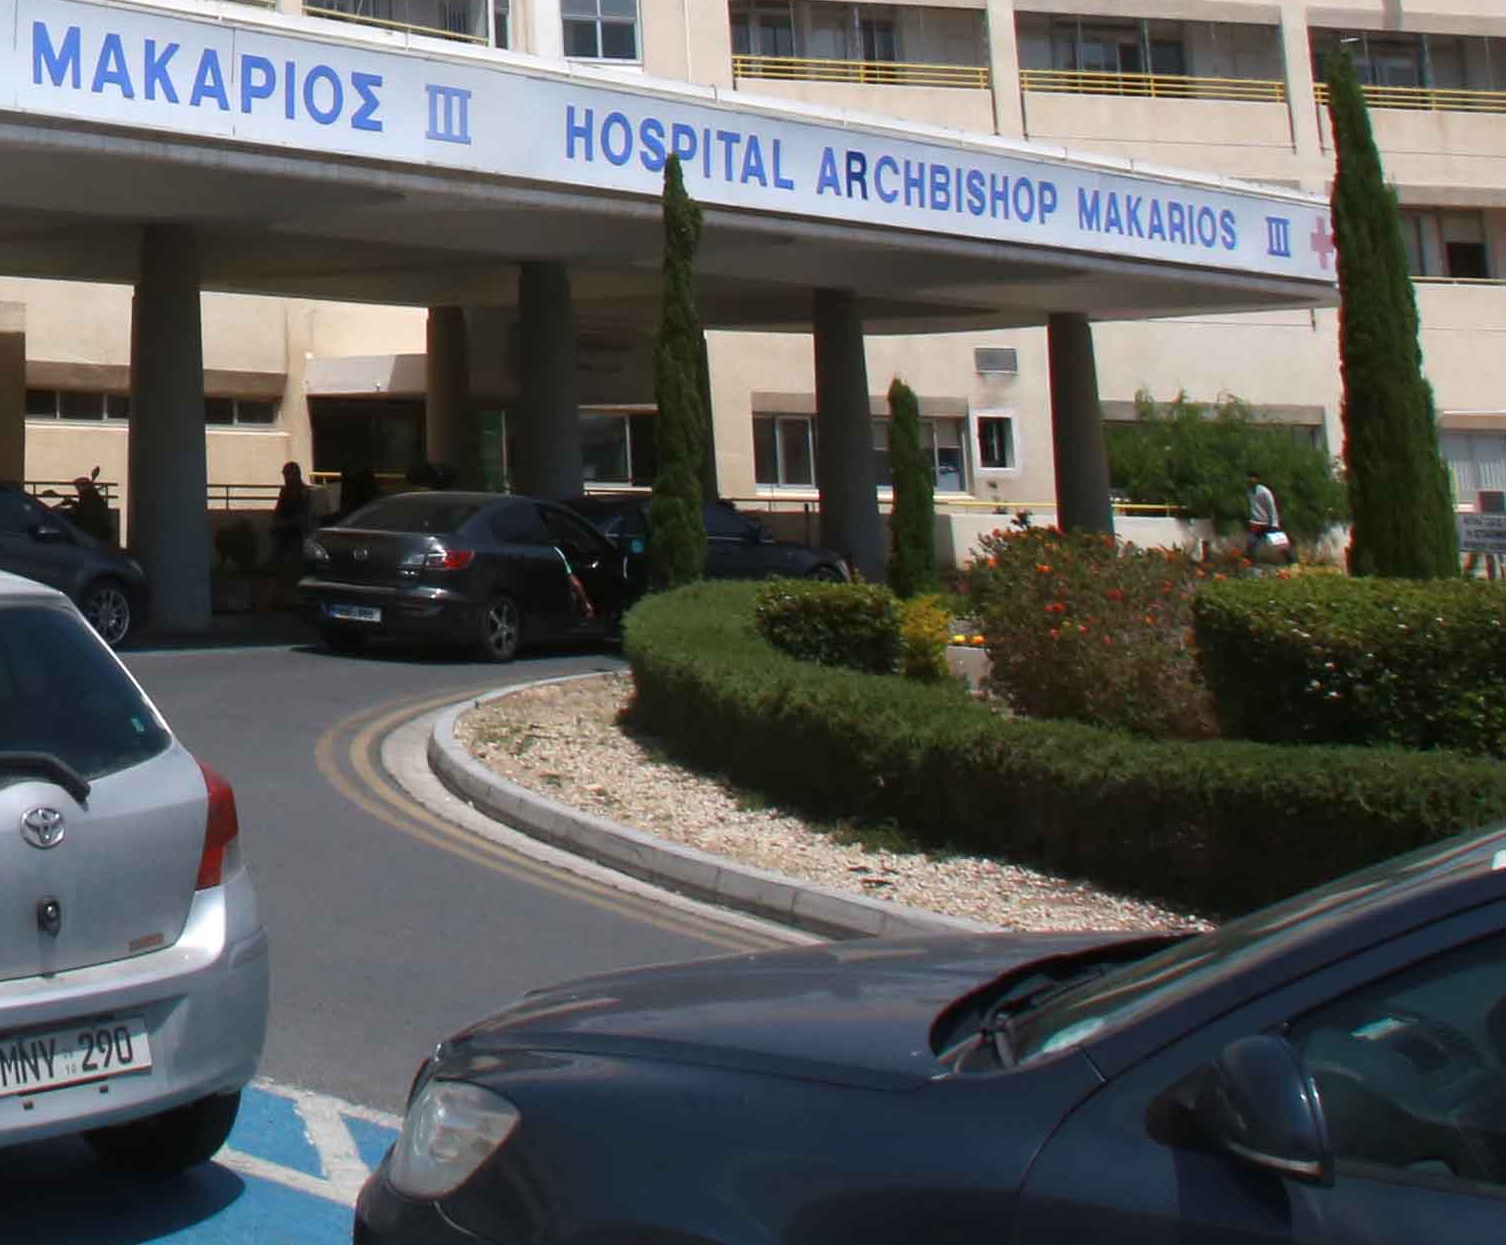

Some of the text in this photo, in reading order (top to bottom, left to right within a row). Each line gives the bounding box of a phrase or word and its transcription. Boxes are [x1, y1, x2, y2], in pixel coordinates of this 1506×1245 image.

[32, 21, 384, 132] ΜΑΚΑΡΙΟΣ
[566, 105, 1293, 260] HOSPITAL ARCHBISHOP MAKARIOS III
[77, 1025, 133, 1072] 290
